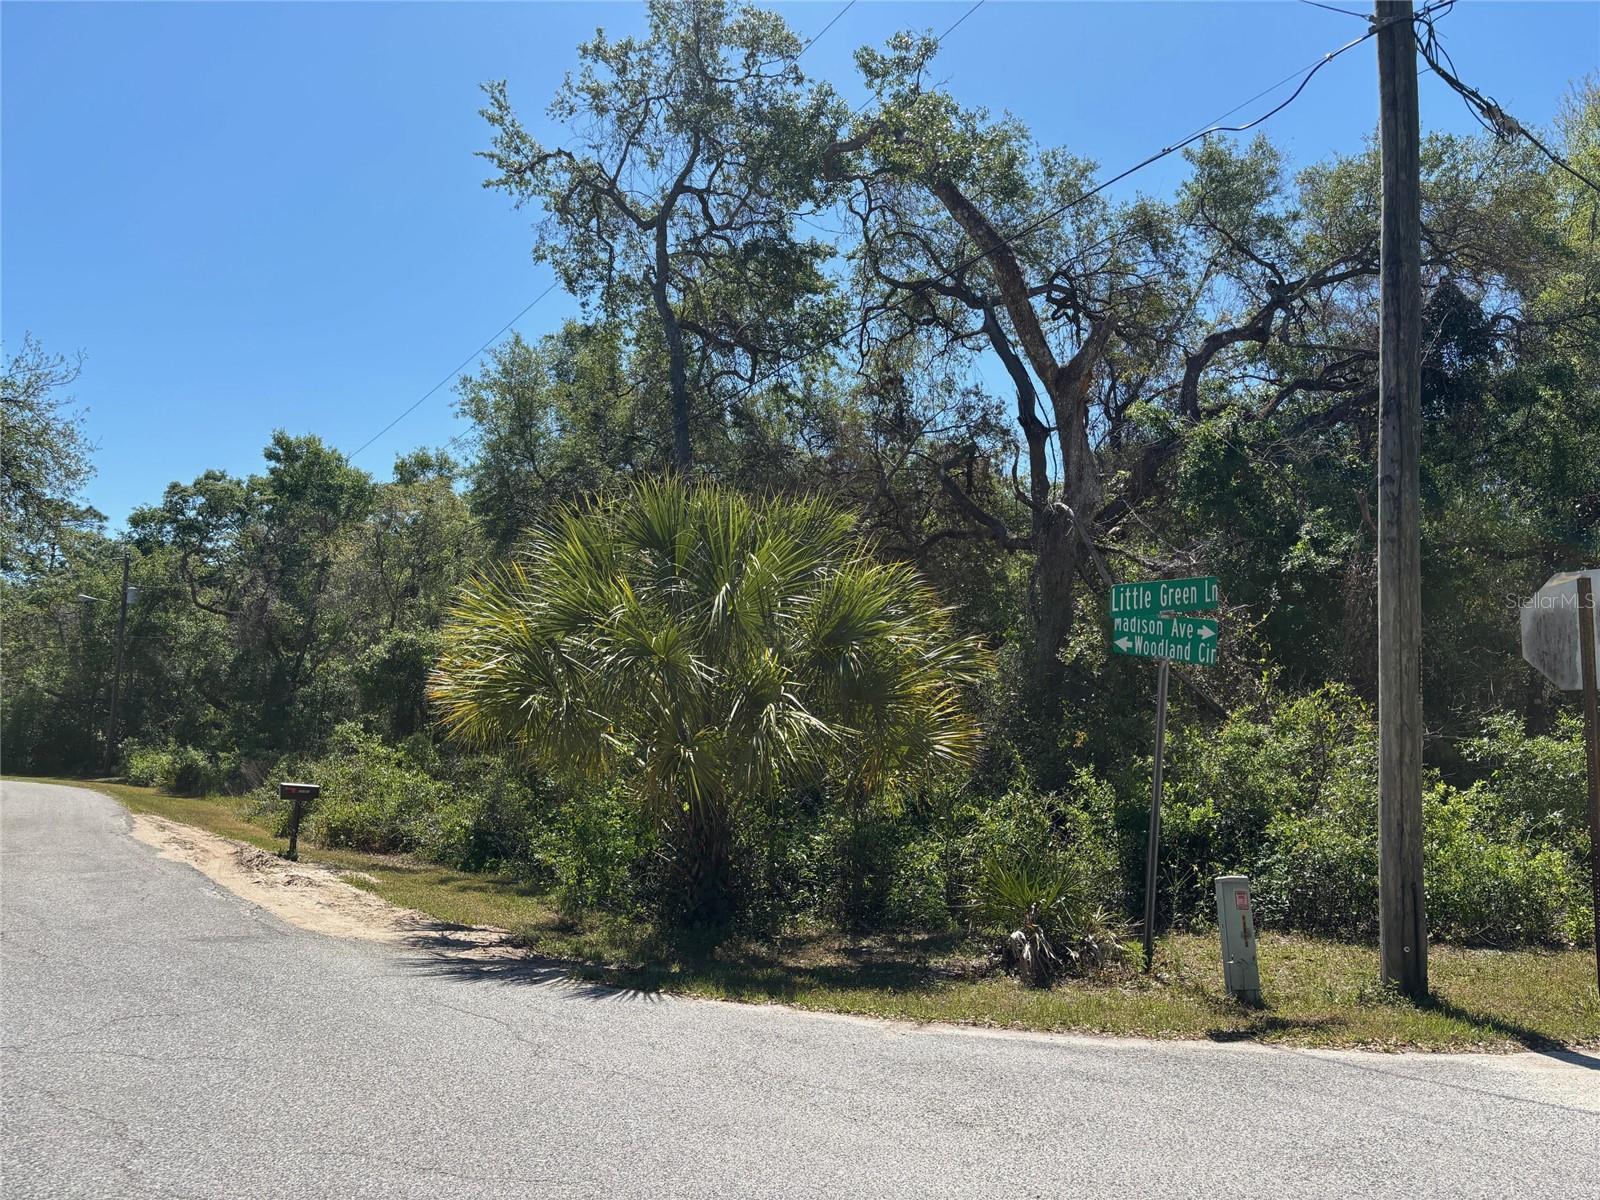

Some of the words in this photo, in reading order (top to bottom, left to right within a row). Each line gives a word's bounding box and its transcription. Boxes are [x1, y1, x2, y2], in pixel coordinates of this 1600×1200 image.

[1112, 587, 1151, 611] Little
[1160, 583, 1197, 607] Green
[1205, 580, 1218, 602] Ln
[1114, 617, 1163, 636] Madison
[1171, 618, 1193, 639] Ave
[1134, 635, 1191, 660] Woodland
[1198, 643, 1217, 664] Cir
